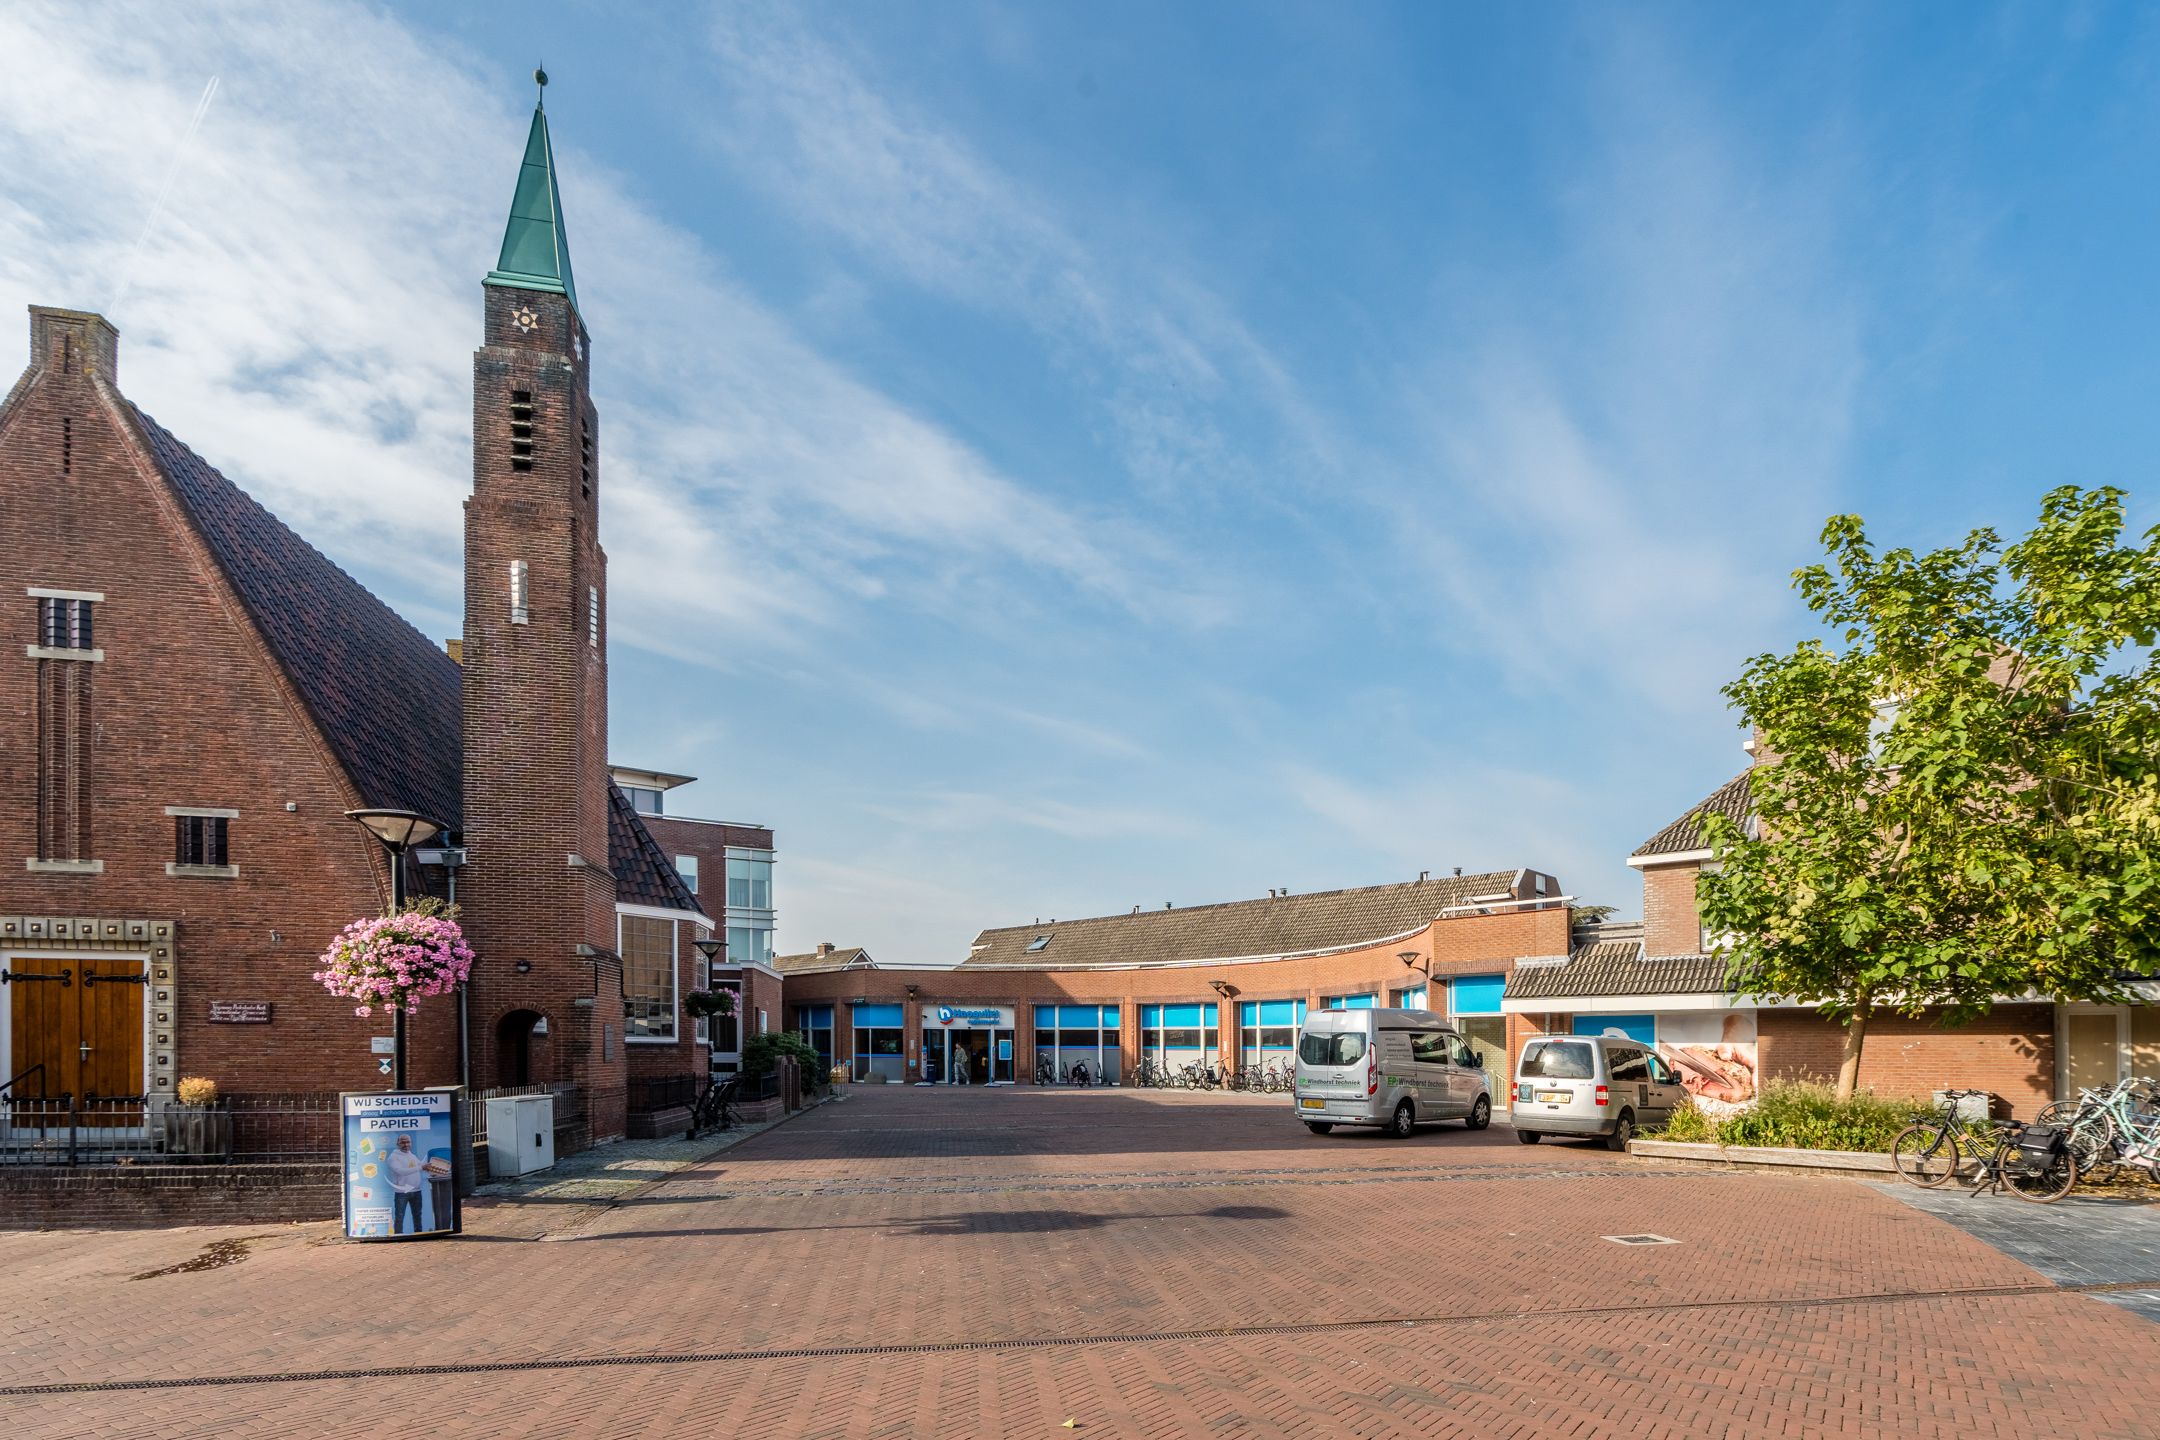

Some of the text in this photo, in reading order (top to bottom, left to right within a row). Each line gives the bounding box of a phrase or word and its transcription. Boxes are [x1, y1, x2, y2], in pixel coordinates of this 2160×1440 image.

[1307, 1078, 1334, 1086] Windhorst
[1335, 1079, 1361, 1087] techniek
[1399, 1077, 1427, 1088] Windhorst
[353, 1096, 439, 1107] WIJ SCHEIDEN
[370, 1118, 419, 1130] PAPIER
